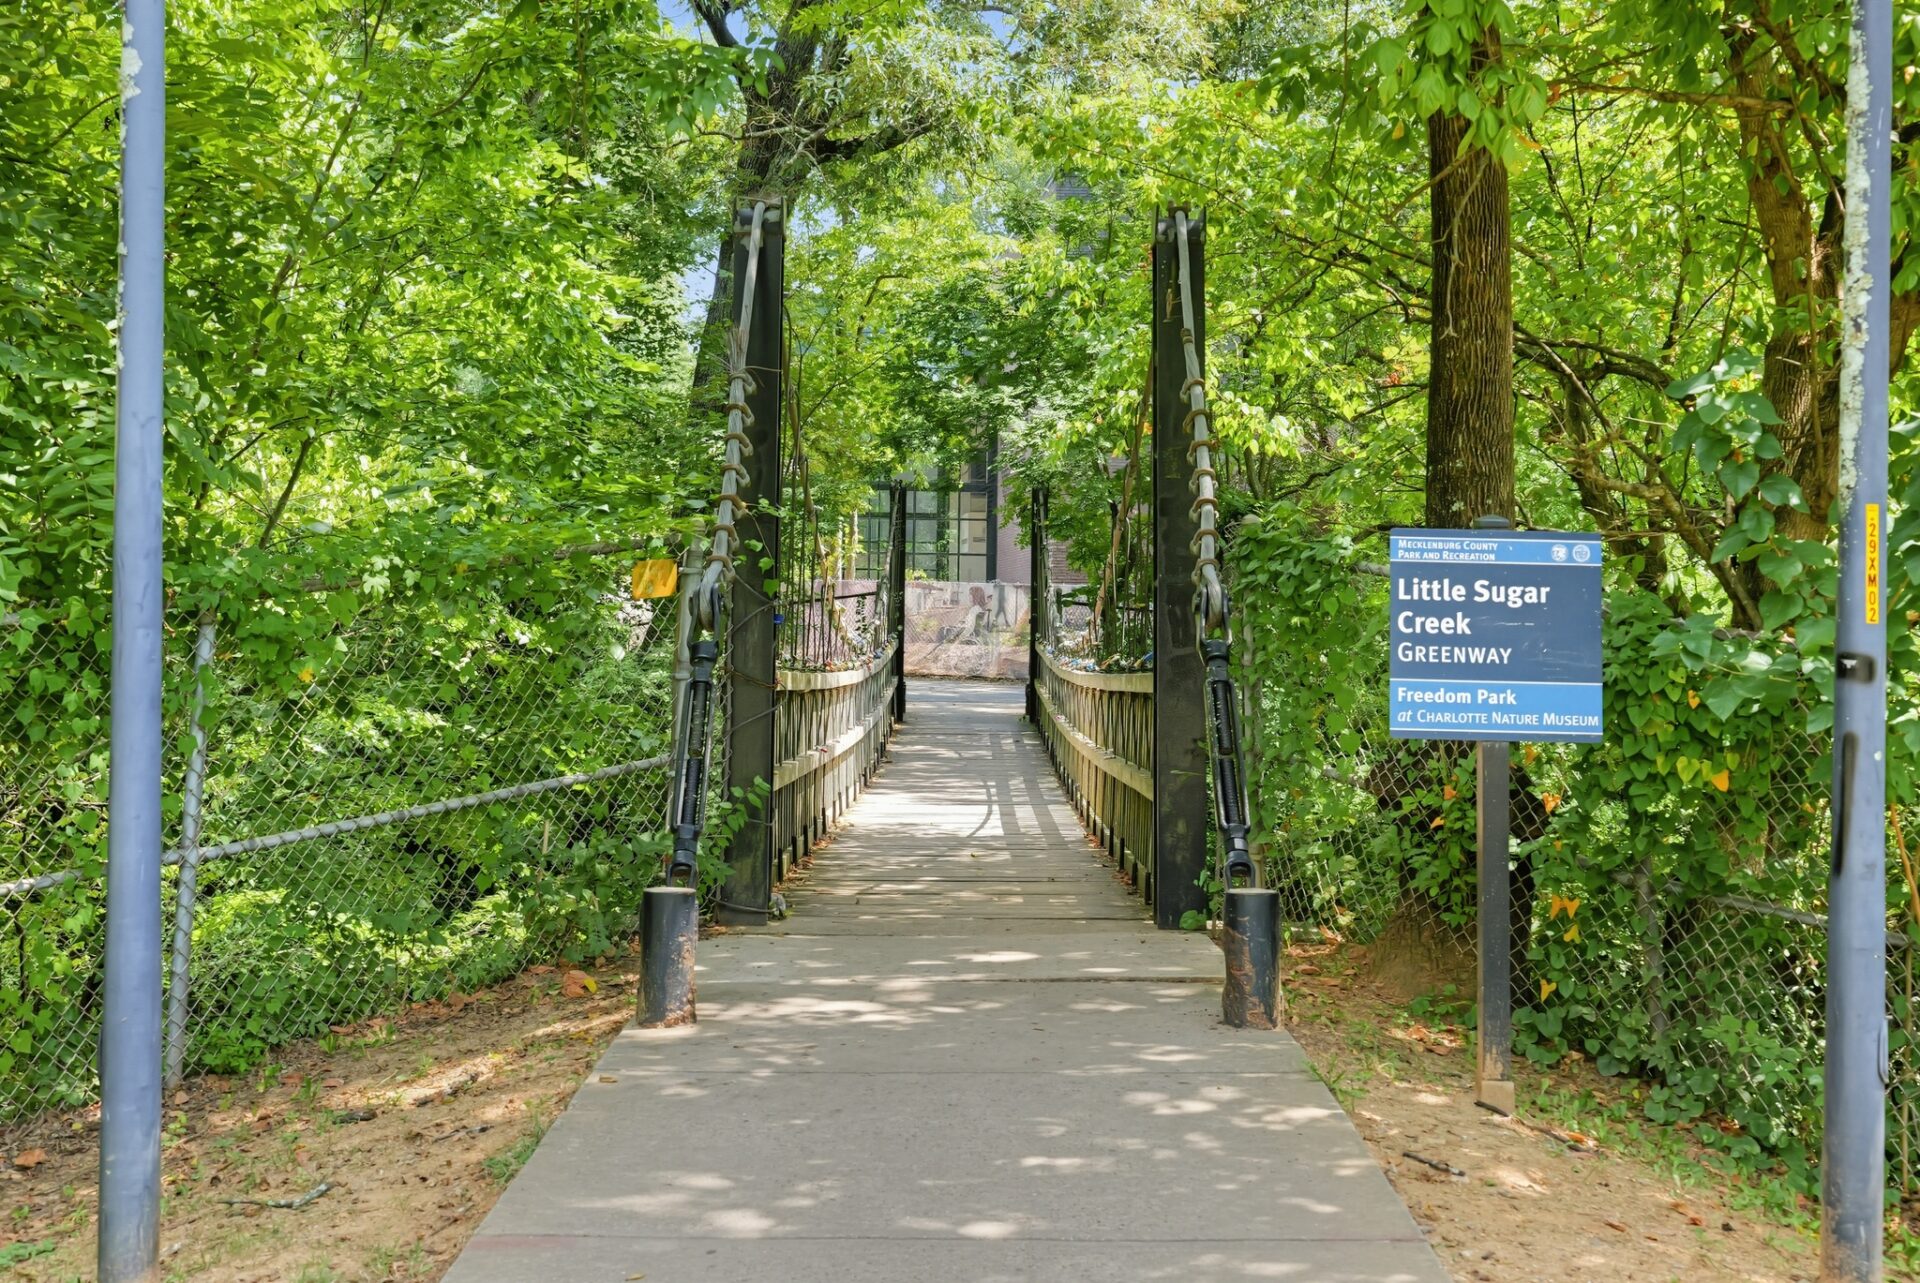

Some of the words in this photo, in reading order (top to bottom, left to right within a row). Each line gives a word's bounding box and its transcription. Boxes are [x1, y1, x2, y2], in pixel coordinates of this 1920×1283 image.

[1398, 540, 1461, 549] MECKLENBURG
[1464, 540, 1497, 550] COUNTY
[1398, 551, 1420, 559] PARK
[1423, 552, 1440, 560] AND
[1443, 551, 1495, 560] RECREATION
[1398, 578, 1466, 602] Little
[1474, 580, 1550, 608] Sugar
[1398, 611, 1471, 635] Creek
[1398, 642, 1512, 664] GREENWAY
[1398, 688, 1470, 704] Freedom
[1478, 689, 1516, 704] Park
[1398, 710, 1412, 722] at
[1417, 710, 1487, 724] CHARLOTTE
[1492, 711, 1539, 725] NATURE
[1544, 713, 1598, 726] MUSEUM
